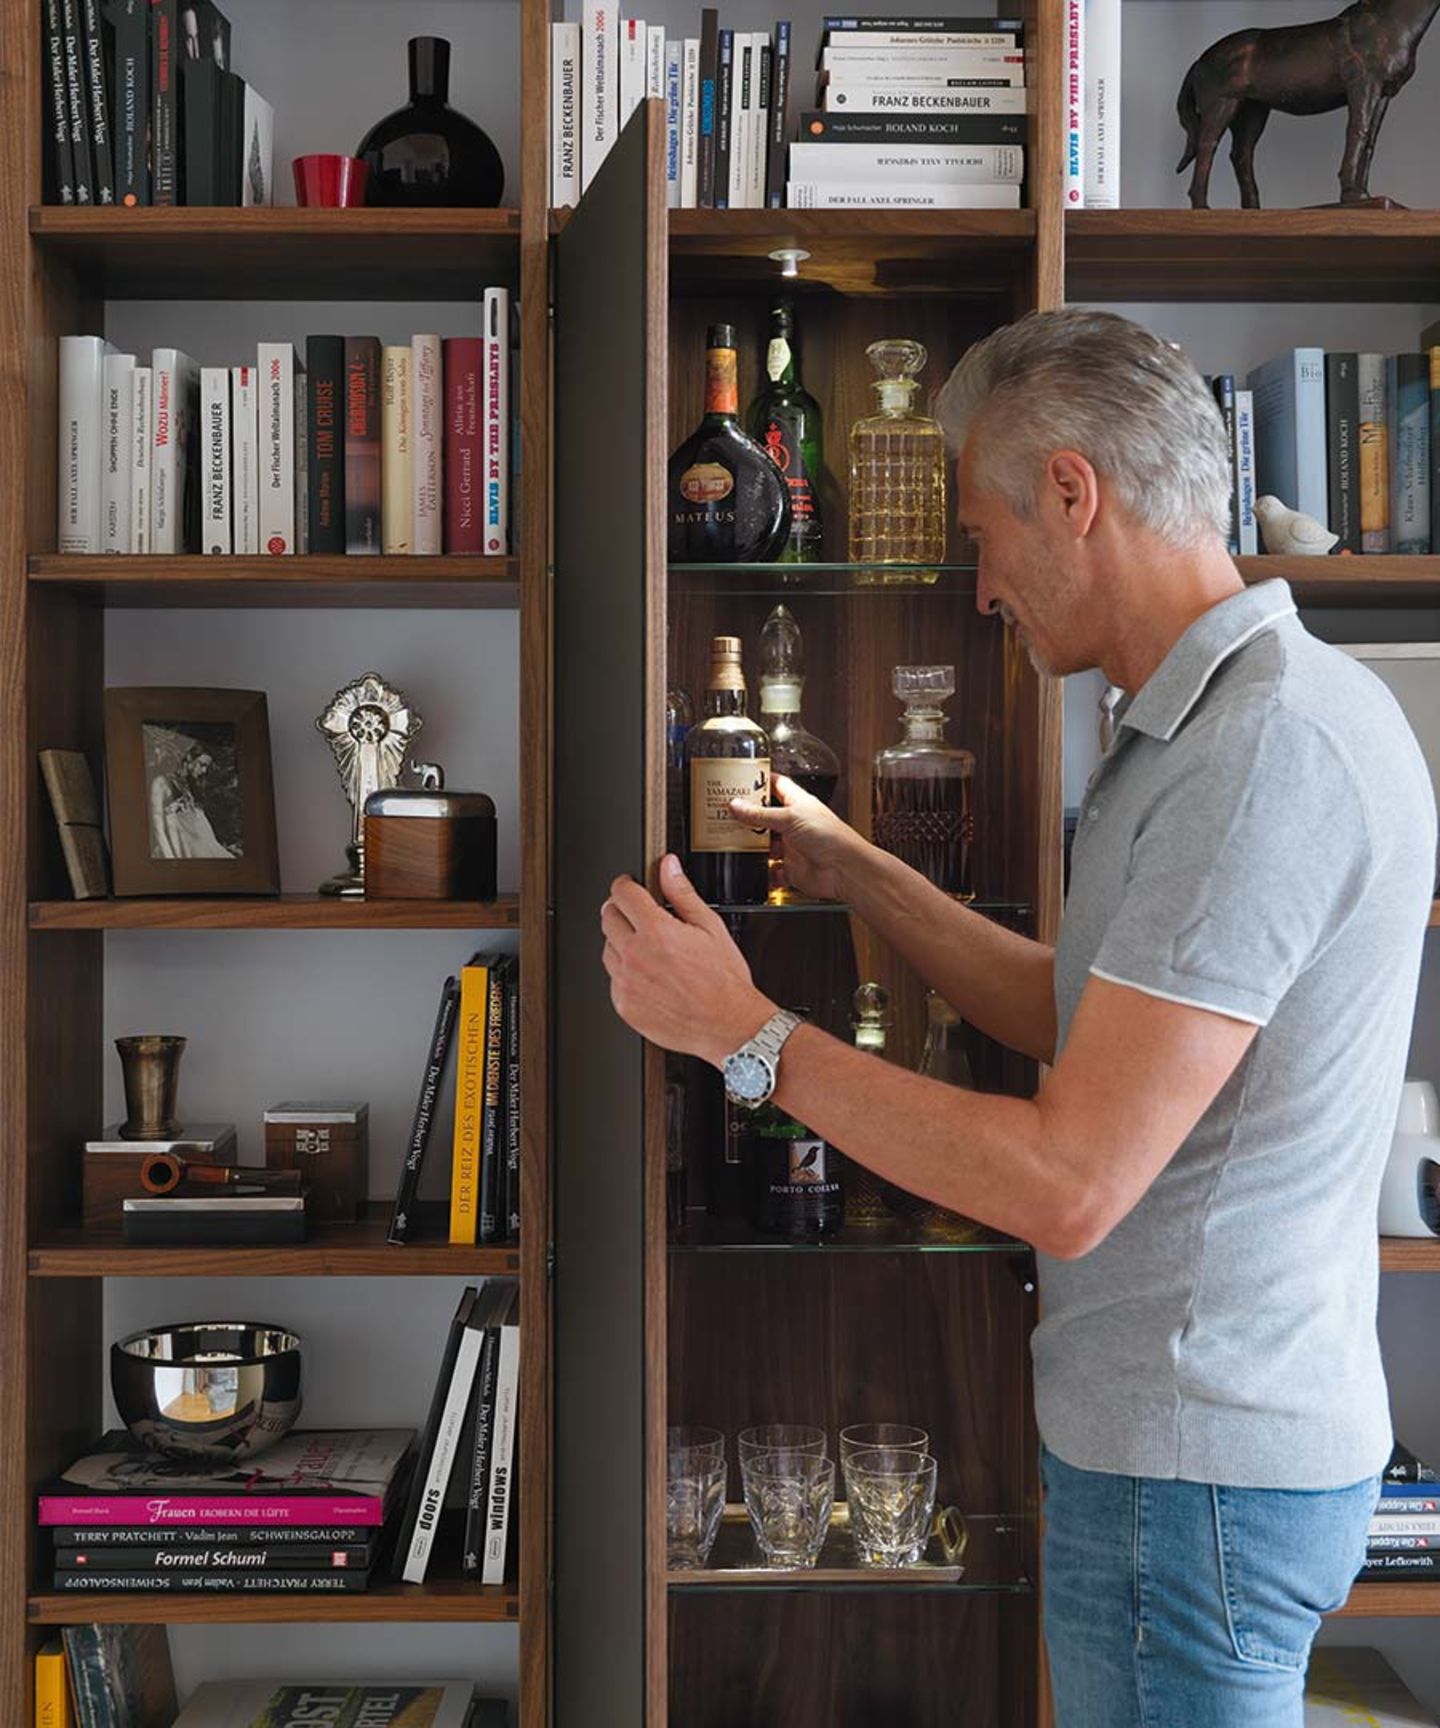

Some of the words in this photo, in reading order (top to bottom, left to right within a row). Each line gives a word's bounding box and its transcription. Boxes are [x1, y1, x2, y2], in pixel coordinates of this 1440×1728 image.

[595, 10, 605, 32] 2006
[1070, 0, 1079, 69] PRESLEY
[66, 36, 76, 54] Der
[89, 39, 99, 57] Der
[68, 55, 78, 82] Maler
[90, 58, 101, 85] Maler
[126, 58, 134, 87] KOCH
[595, 34, 604, 94] Weltalmanach
[669, 62, 679, 79] Tür
[70, 82, 80, 119] Herbert
[92, 85, 104, 121] Herbert
[563, 59, 573, 138] BECKENBAUER
[668, 81, 680, 108] grüne
[872, 96, 909, 108] FRANZ
[912, 96, 990, 108] BECKENBAUER
[1070, 74, 1079, 105] THE
[595, 95, 604, 125] Fischer
[668, 109, 678, 124] Die
[1070, 109, 1079, 128] BY
[595, 127, 604, 142] Der
[886, 124, 926, 133] ROLAND
[929, 124, 958, 133] KOCH
[563, 142, 573, 178] FRANZ
[1070, 133, 1079, 176] ELVIS
[829, 196, 845, 204] DER
[847, 196, 868, 204] FALL
[892, 197, 935, 205] SPRINGER
[270, 359, 281, 380] 2006
[489, 343, 499, 420] PRESLEYS
[160, 371, 169, 410] Männer?
[317, 380, 333, 427] CRUISE
[466, 372, 476, 435] Freundschaft
[270, 382, 281, 441] Weltalmanach
[455, 404, 463, 435] Allein
[1239, 411, 1249, 428] Tür
[70, 420, 78, 461] SPRINGER
[212, 402, 223, 481] BECKENBAUER
[317, 431, 333, 460] TOM
[489, 423, 499, 454] THE
[1240, 430, 1252, 455] grüne
[1340, 419, 1348, 449] KOCH
[271, 442, 281, 472] Fischer
[489, 458, 499, 479] BY
[1240, 457, 1250, 472] Die
[1340, 451, 1349, 489] ROLAND
[70, 462, 78, 484] AXEL
[271, 473, 281, 488] Der
[427, 451, 436, 511] PATTERSON
[459, 448, 471, 494] Gerrard
[70, 485, 78, 505] FALL
[212, 483, 223, 520] FRANZ
[489, 482, 499, 526] ELVIS
[70, 506, 78, 524] DER
[460, 496, 472, 528] Nicci
[675, 511, 735, 524] MATEUS
[706, 788, 751, 796] YAMAZAKI
[716, 809, 728, 820] 12
[489, 1028, 501, 1047] DES
[464, 1012, 479, 1109] EXOTISCHEN
[488, 1050, 500, 1092] DIENSTE
[509, 1064, 519, 1081] Der
[427, 1065, 440, 1084] Der
[420, 1085, 436, 1111] Maler
[509, 1083, 519, 1110] Maler
[412, 1111, 431, 1148] Herbert
[462, 1114, 474, 1142] DES
[509, 1110, 519, 1147] Herbert
[406, 1147, 422, 1171] Vogt
[461, 1148, 473, 1180] REIZ
[507, 1148, 519, 1170] Vogt
[459, 1186, 471, 1214] DER
[480, 1403, 490, 1421] Der
[476, 1422, 489, 1450] Maler
[473, 1449, 487, 1487] Herbert
[146, 1499, 196, 1524] Frauen
[200, 1509, 242, 1517] EROBERN
[243, 1509, 259, 1517] DIE
[420, 1488, 440, 1531] doors
[470, 1487, 482, 1510] Vogt
[490, 1467, 507, 1531] windows
[74, 1532, 109, 1542] TERRY
[112, 1532, 177, 1542] PRATCHETT
[185, 1531, 215, 1541] Vadim
[217, 1532, 238, 1542] Jean
[250, 1530, 355, 1541] SCHWEINSGALOPP
[155, 1552, 209, 1566] Formel
[212, 1552, 267, 1566] Schumi
[1385, 1556, 1434, 1567] Lefkowith
[65, 1578, 170, 1588] SCHWEINSGALOPP
[182, 1577, 203, 1588] Jean
[204, 1578, 235, 1588] Vadim
[243, 1578, 308, 1588] PRATCHETT
[310, 1578, 346, 1588] TERRY
